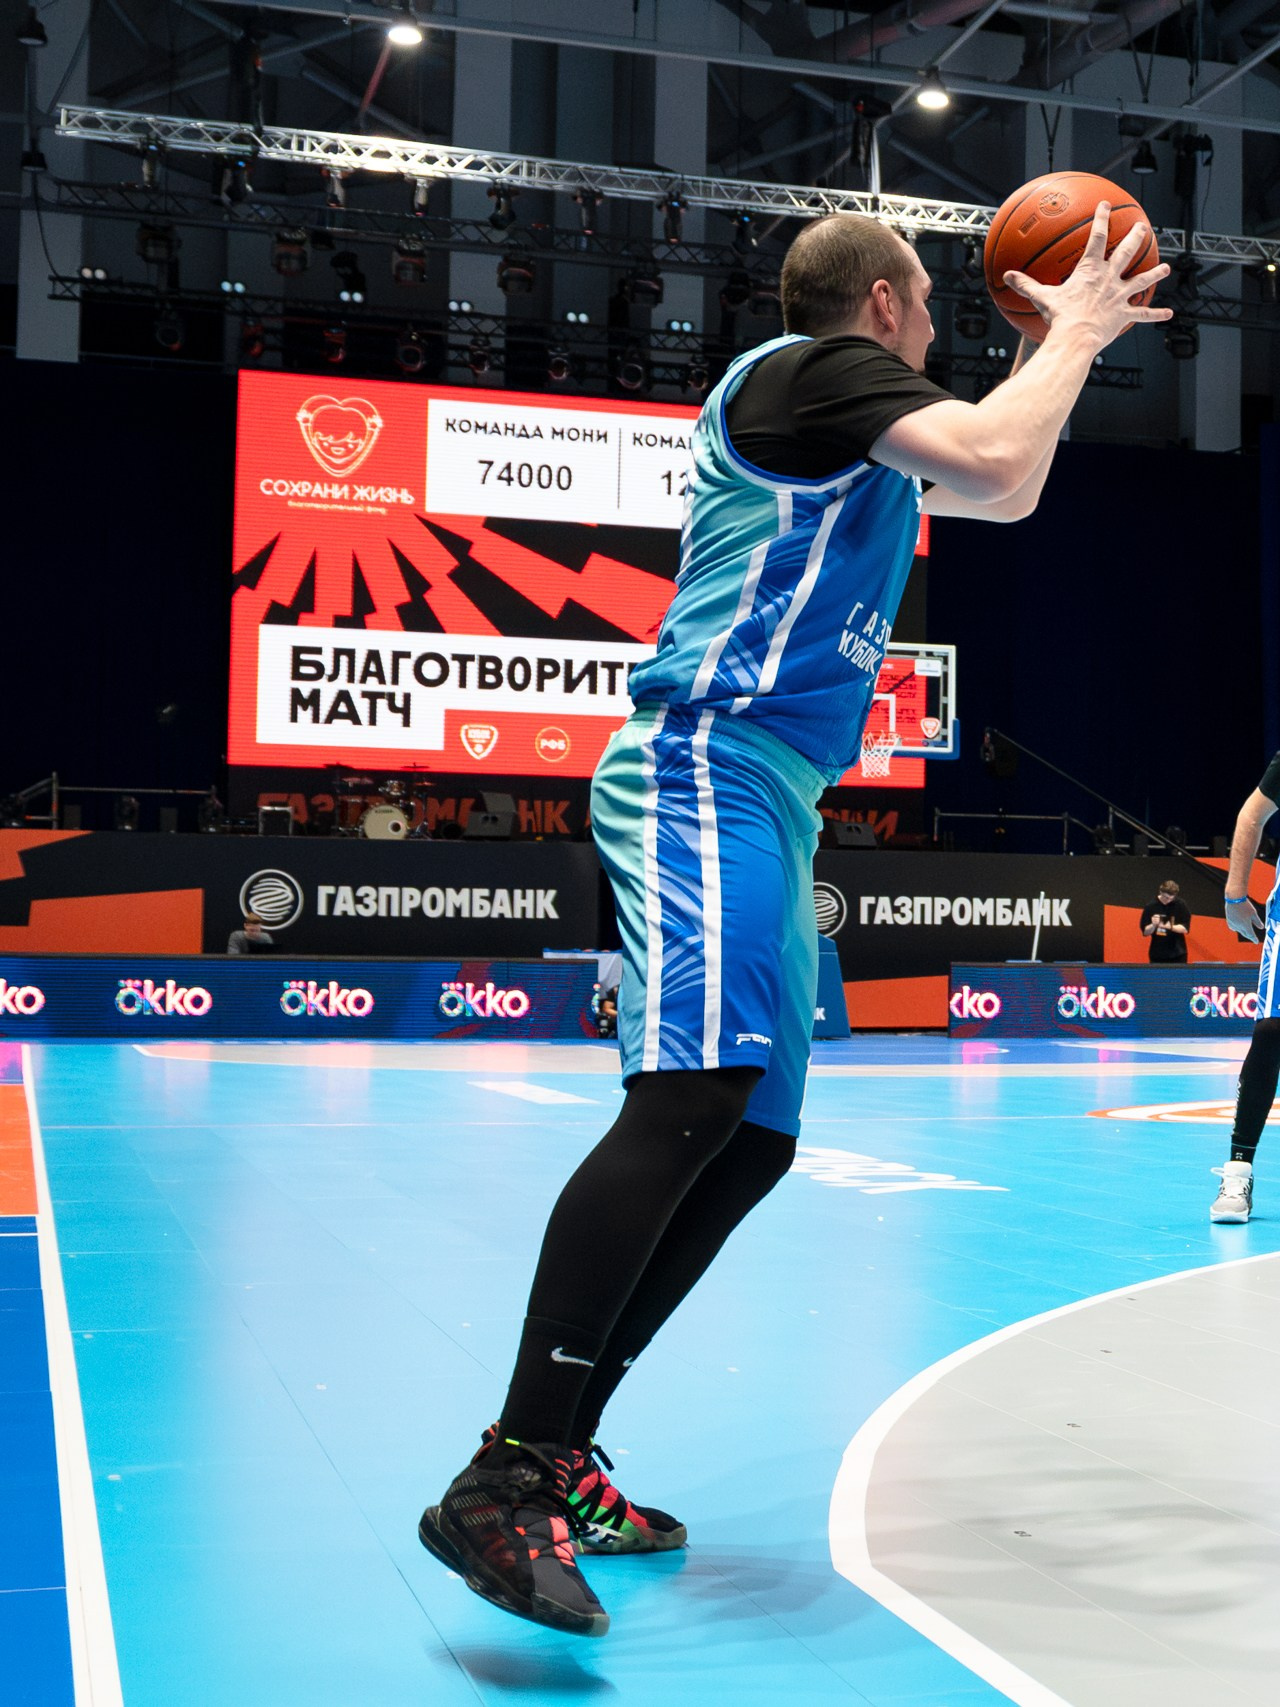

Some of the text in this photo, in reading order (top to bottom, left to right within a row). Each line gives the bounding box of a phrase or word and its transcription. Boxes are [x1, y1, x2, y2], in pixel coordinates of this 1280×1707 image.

[445, 418, 608, 443] КОМАНДА МОНИ
[478, 459, 572, 490] 74000
[260, 478, 415, 505] СОХРАНИ ЖИЗНЬ
[837, 628, 883, 676] КУБОК
[290, 645, 633, 696] БЛАГОТВОРИТ
[289, 687, 412, 728] МАТЧ
[317, 885, 559, 919] ГАЗПРОМБАНК
[859, 896, 1073, 927] ГАЗПРОМБАНК
